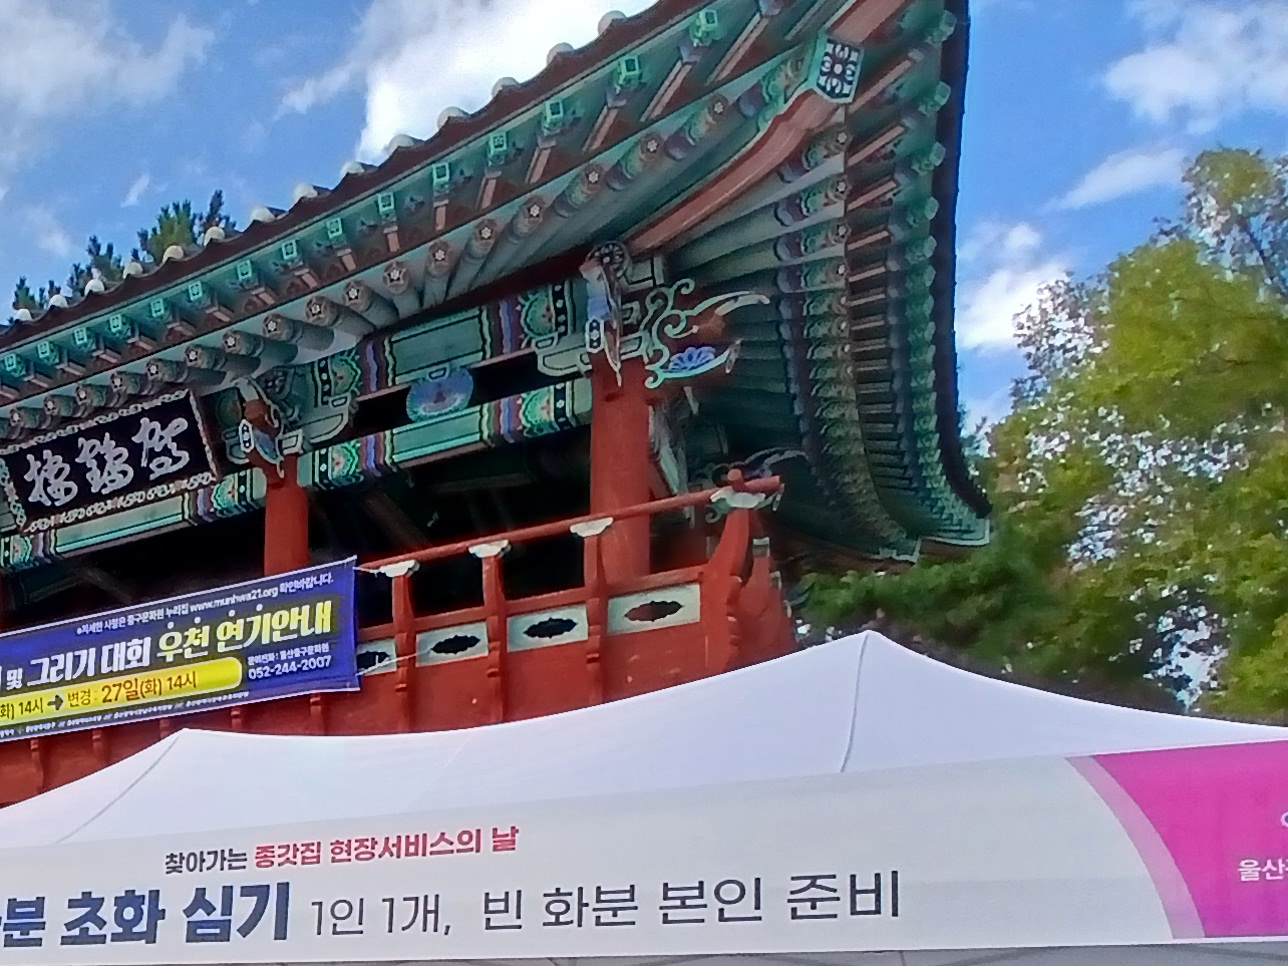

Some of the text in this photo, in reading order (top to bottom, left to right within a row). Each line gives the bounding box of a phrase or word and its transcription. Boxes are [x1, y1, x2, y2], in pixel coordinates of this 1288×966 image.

[6, 667, 24, 691] 및
[27, 647, 97, 687] 그리기
[101, 636, 152, 674] 대회
[156, 625, 211, 663] 우천
[248, 655, 333, 680] 052-244-2007
[18, 697, 45, 716] 14시
[67, 688, 92, 708] 변경
[101, 678, 163, 704] 27일(화)
[167, 671, 198, 691] 14시
[165, 825, 520, 875] 찾아가는 종갓집 현장서비스의 날
[1238, 858, 1288, 882] 울산
[60, 887, 167, 946] 초화
[182, 881, 290, 943] 심기
[312, 897, 364, 936] 1인
[381, 893, 451, 936] 1개,
[483, 889, 523, 931] 빈
[542, 884, 639, 928] 화분
[658, 877, 762, 925] 본인
[787, 870, 900, 922] 준비
